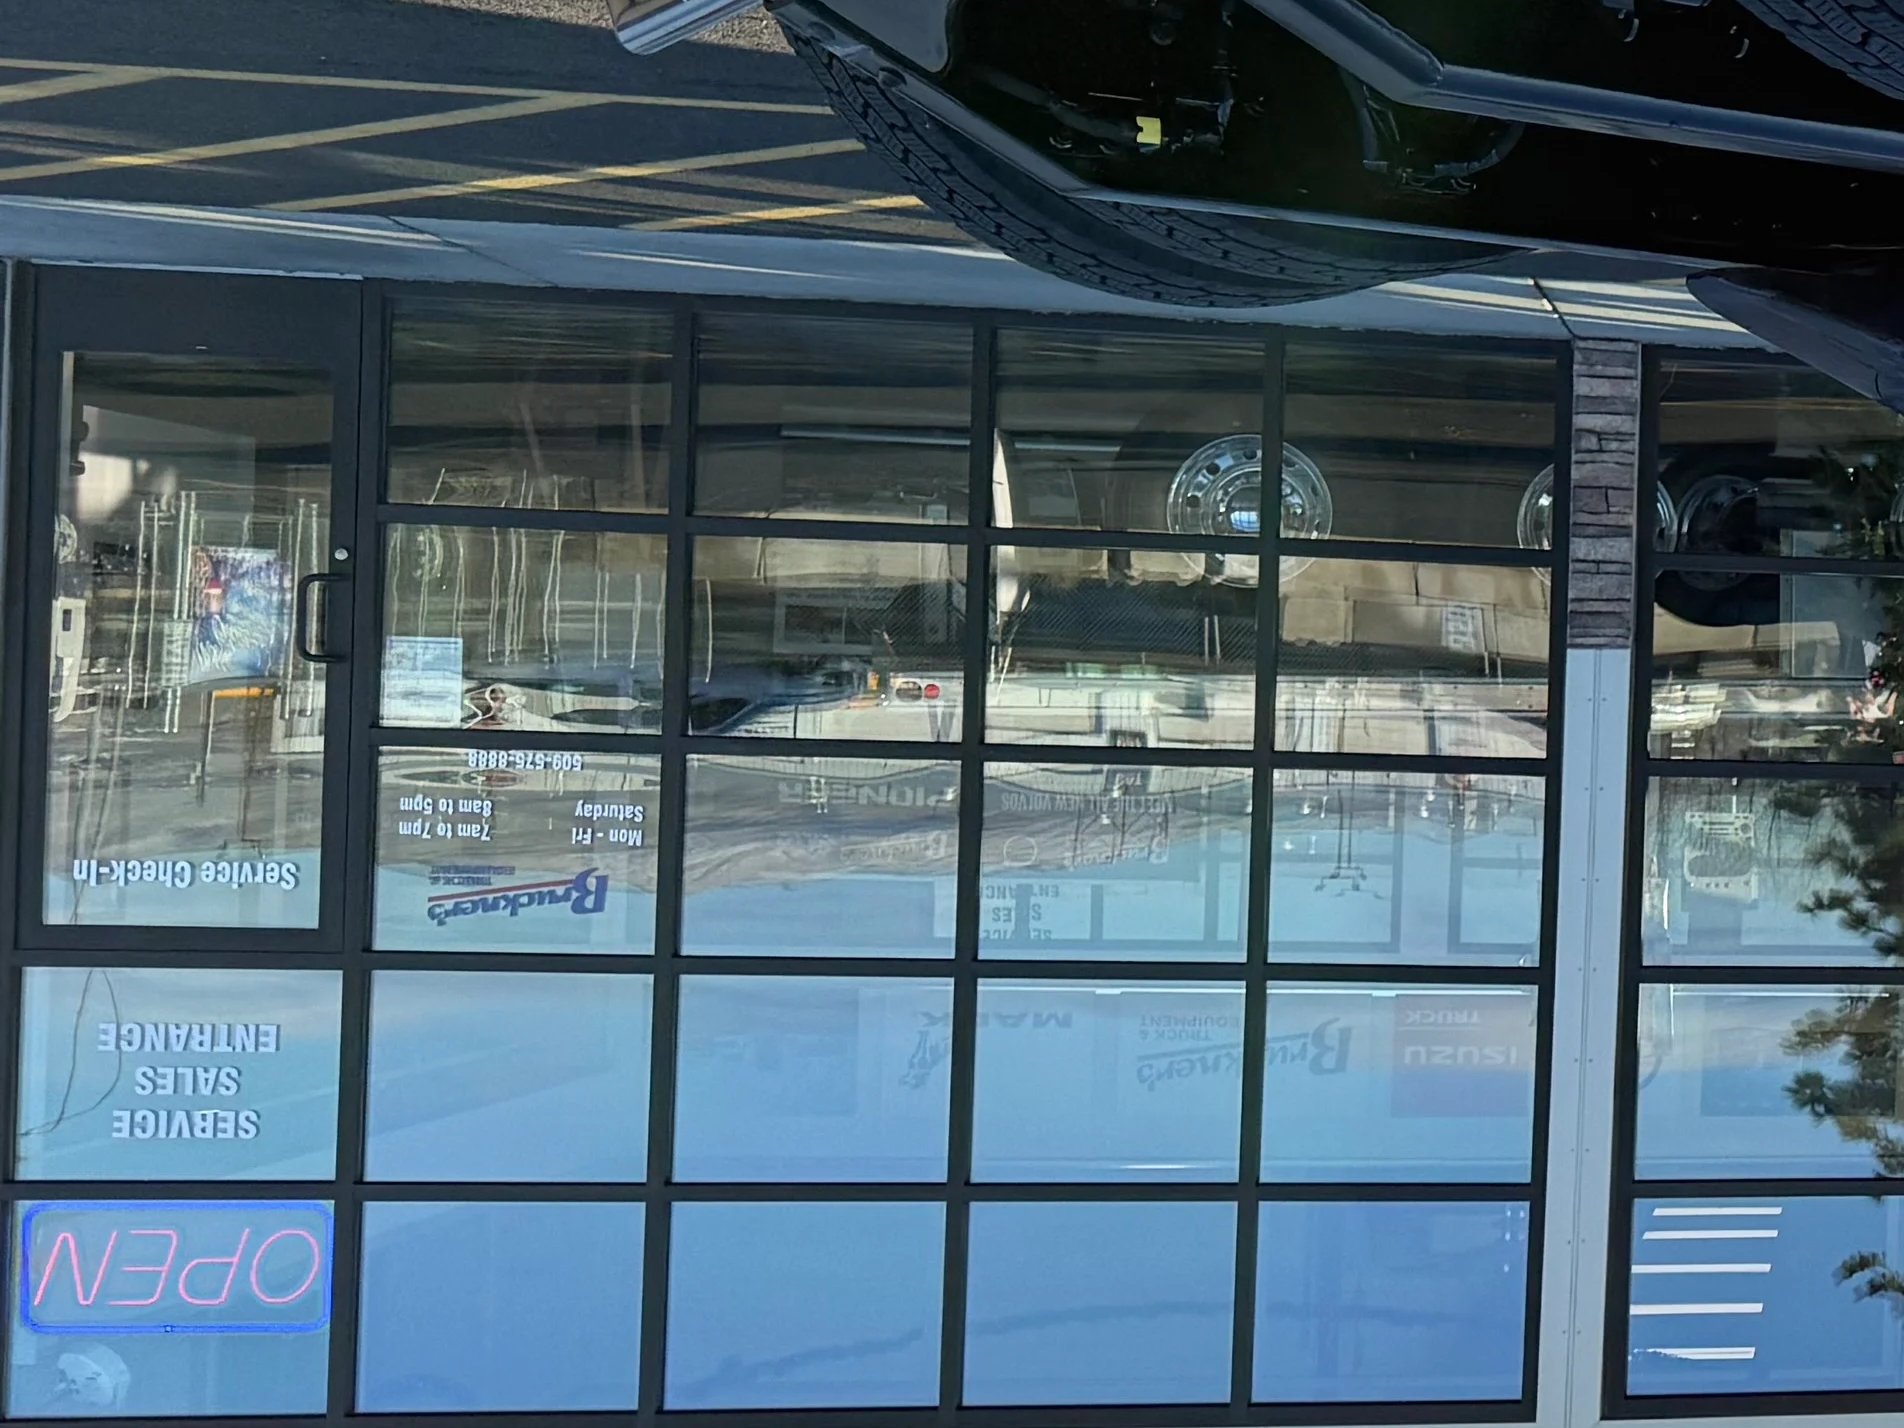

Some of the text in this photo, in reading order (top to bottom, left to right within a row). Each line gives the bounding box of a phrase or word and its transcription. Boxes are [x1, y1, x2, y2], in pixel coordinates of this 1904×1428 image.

[399, 795, 493, 818] 8am to 5pm
[574, 799, 644, 822] Saturday
[398, 818, 491, 842] 7am to 7pm
[609, 827, 643, 847] Mon
[72, 858, 299, 891] Service Check-In
[427, 867, 609, 927] Bruckner's
[1405, 1009, 1481, 1026] TRUCK
[97, 1021, 280, 1053] ENTRANCE
[1135, 1017, 1352, 1094] Brukner's
[1404, 1045, 1518, 1066] ISUZU
[134, 1065, 240, 1096] SALES
[111, 1108, 259, 1140] SERVICE
[33, 1226, 321, 1308] OPEN
